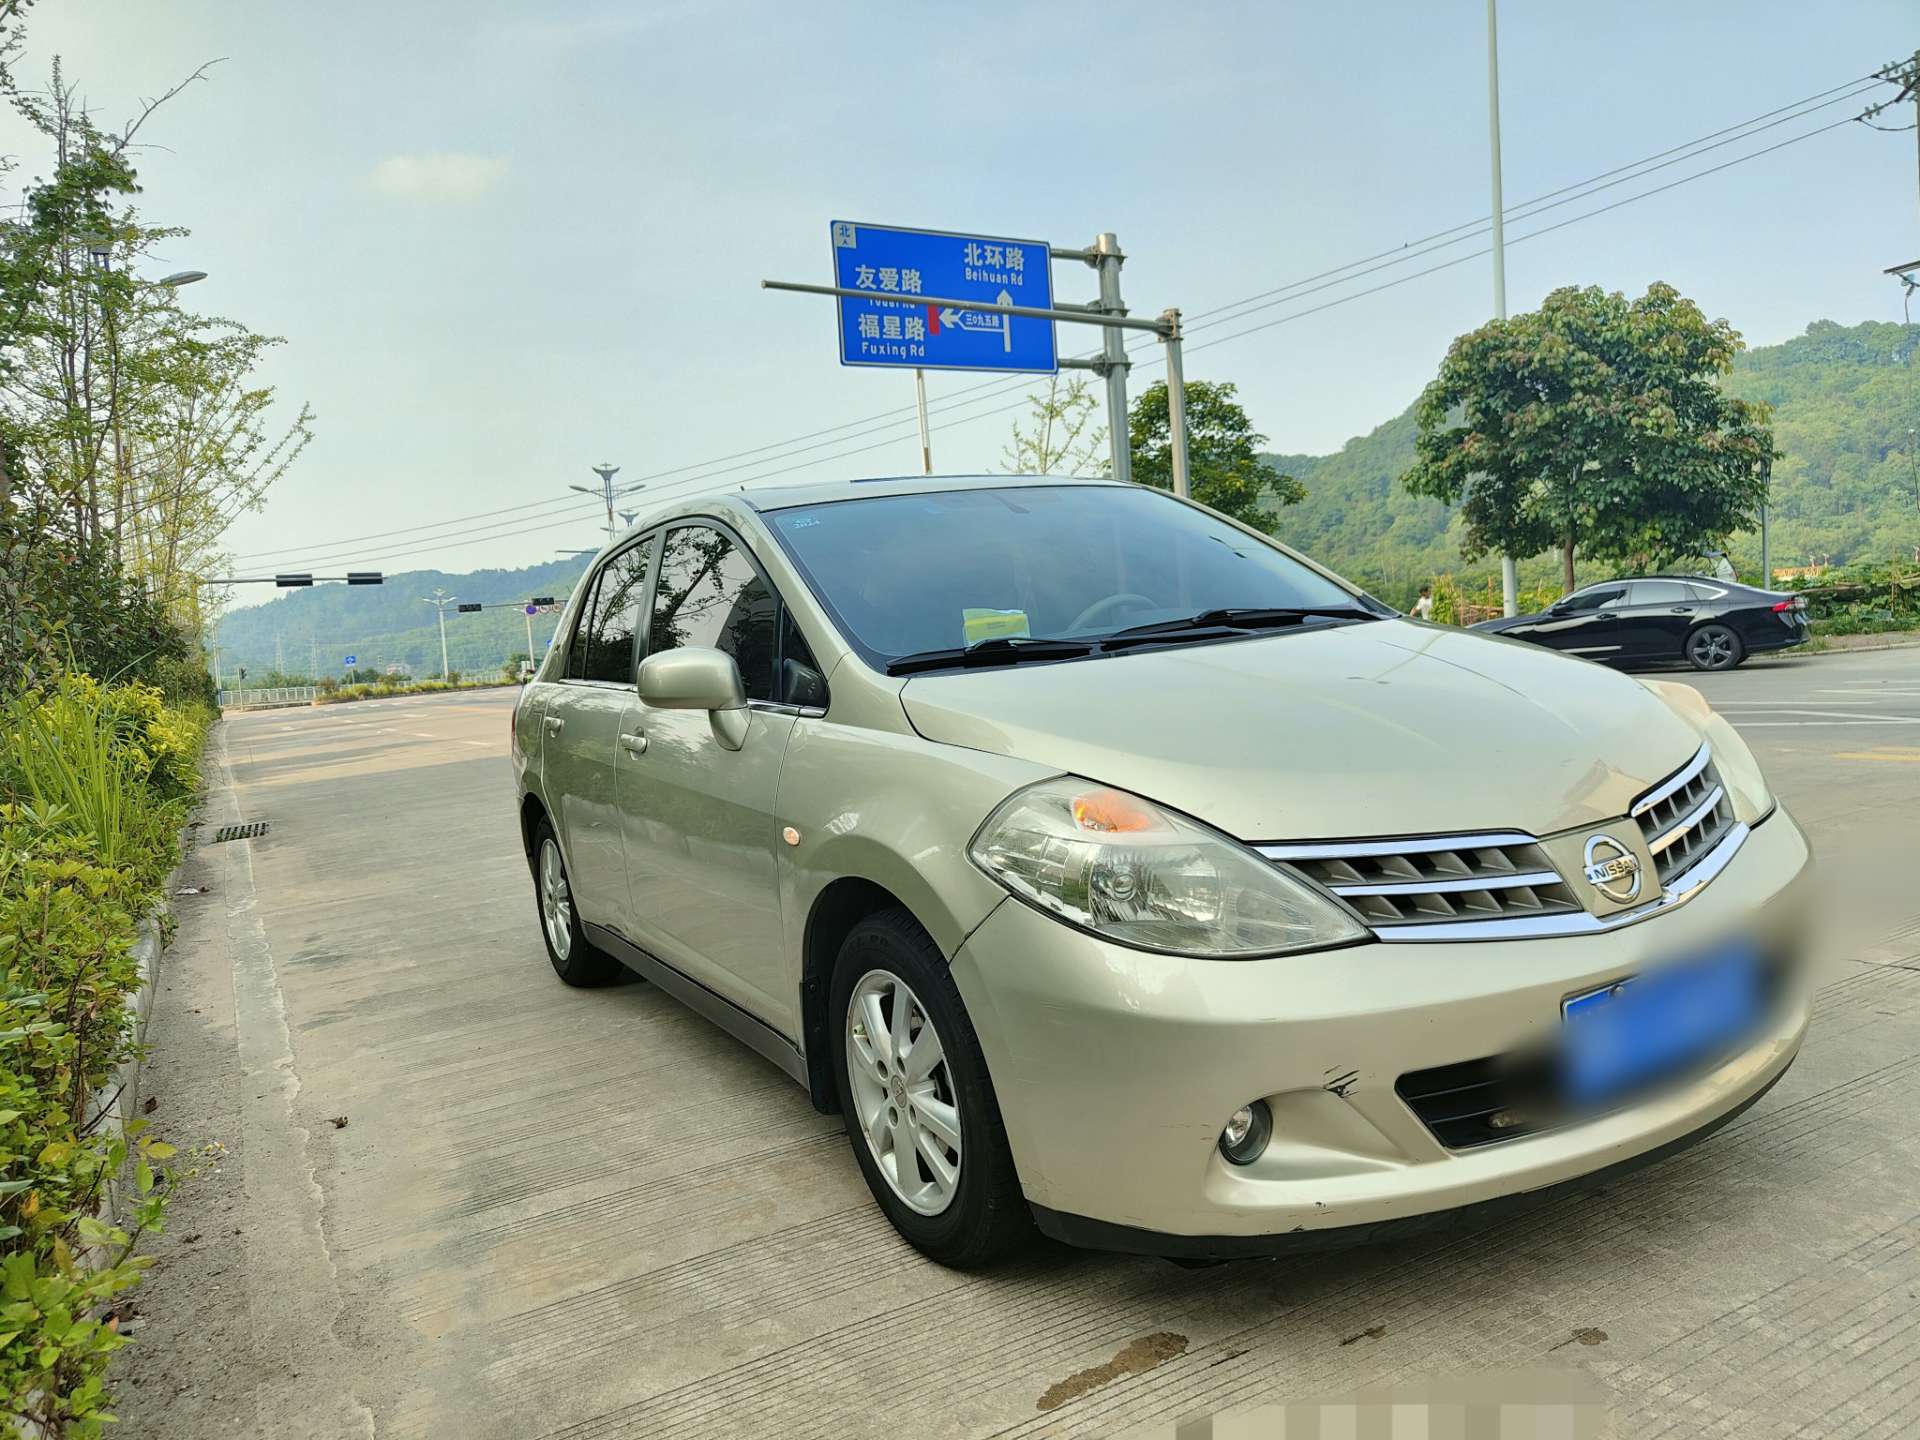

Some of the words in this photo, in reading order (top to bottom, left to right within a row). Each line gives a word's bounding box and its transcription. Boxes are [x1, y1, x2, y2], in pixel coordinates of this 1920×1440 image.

[963, 243, 1025, 271] 北环路
[855, 264, 922, 293] 友爱路
[965, 269, 1008, 284] Beihuan
[1010, 273, 1023, 286] Rd
[858, 313, 925, 341] 福星路
[861, 342, 907, 359] Fuxing
[910, 344, 925, 357] Rd
